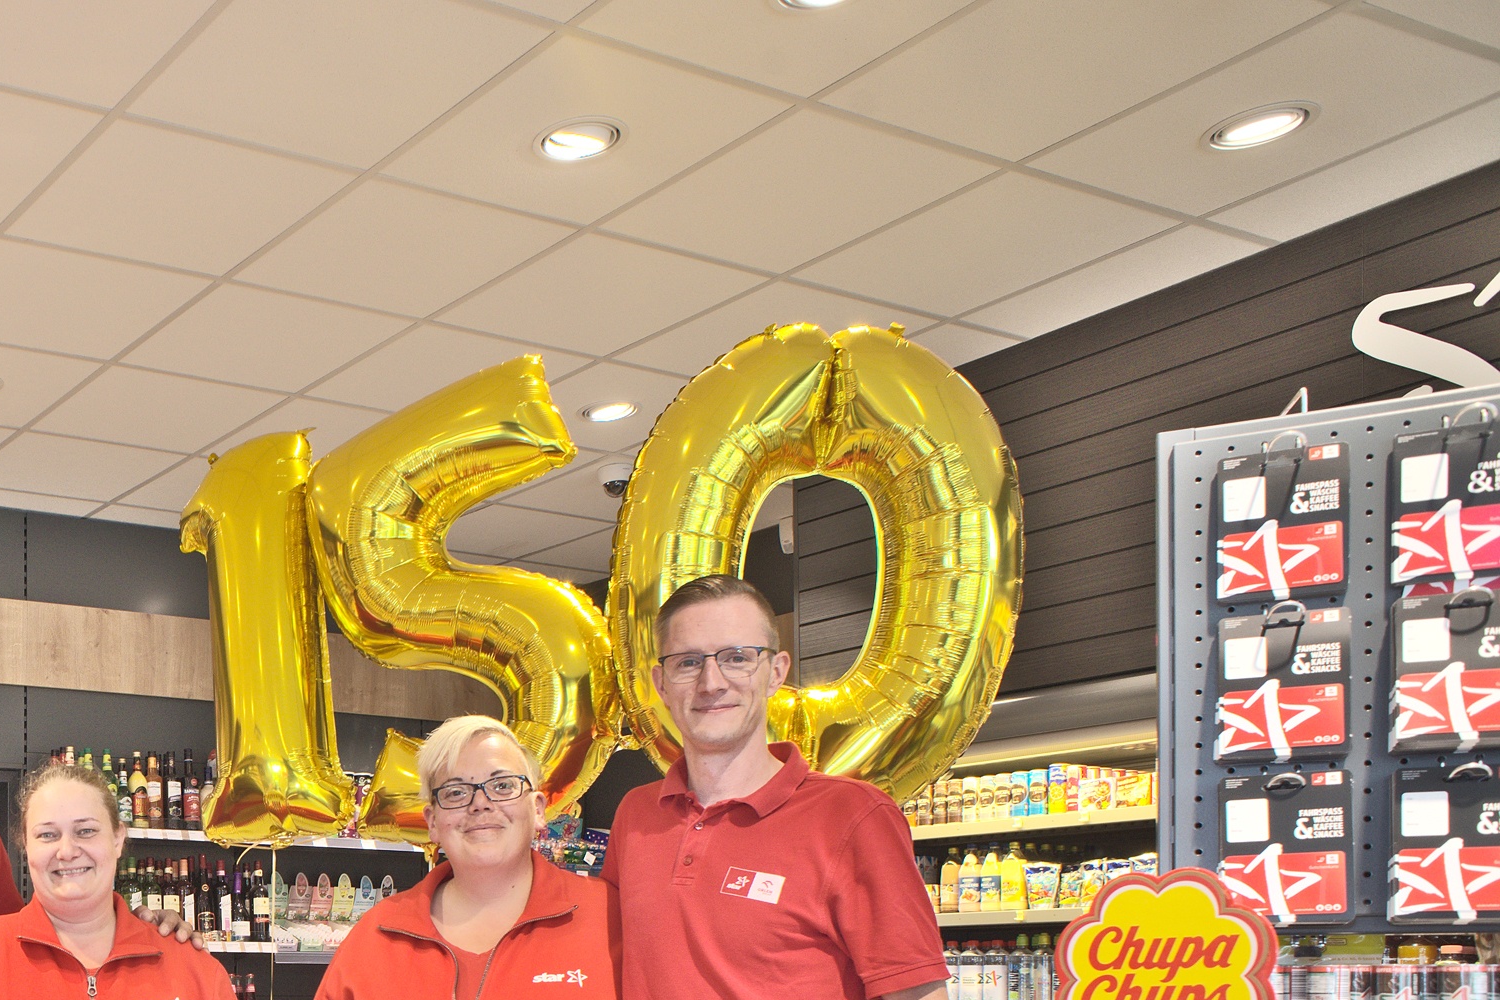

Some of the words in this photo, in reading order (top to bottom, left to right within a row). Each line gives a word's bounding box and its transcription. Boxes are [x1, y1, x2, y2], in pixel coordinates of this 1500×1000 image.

[1295, 479, 1340, 492] FAHRSPASS
[1467, 470, 1494, 493] &
[1310, 486, 1339, 497] WÄSCHE
[1289, 492, 1310, 514] &
[1309, 494, 1339, 504] KAFFEE
[1309, 502, 1340, 512] SNACKS
[178, 320, 1024, 848] 150
[1296, 642, 1341, 653] FAHRSPASS
[1478, 636, 1500, 658] &
[1311, 649, 1340, 658] WÄSCHE
[1291, 653, 1311, 675] &
[1310, 657, 1340, 665] KAFFEE
[1310, 664, 1341, 673] SNACKS
[1298, 807, 1343, 817] FAHRSPASS
[1313, 815, 1344, 824] WÄSCHE
[1476, 812, 1498, 835] &
[1293, 817, 1313, 840] &
[1313, 822, 1344, 831] KAFFEE
[1312, 830, 1344, 838] SNACKS
[726, 882, 743, 891] star
[1088, 925, 1240, 983] Chupa
[532, 972, 565, 983] star
